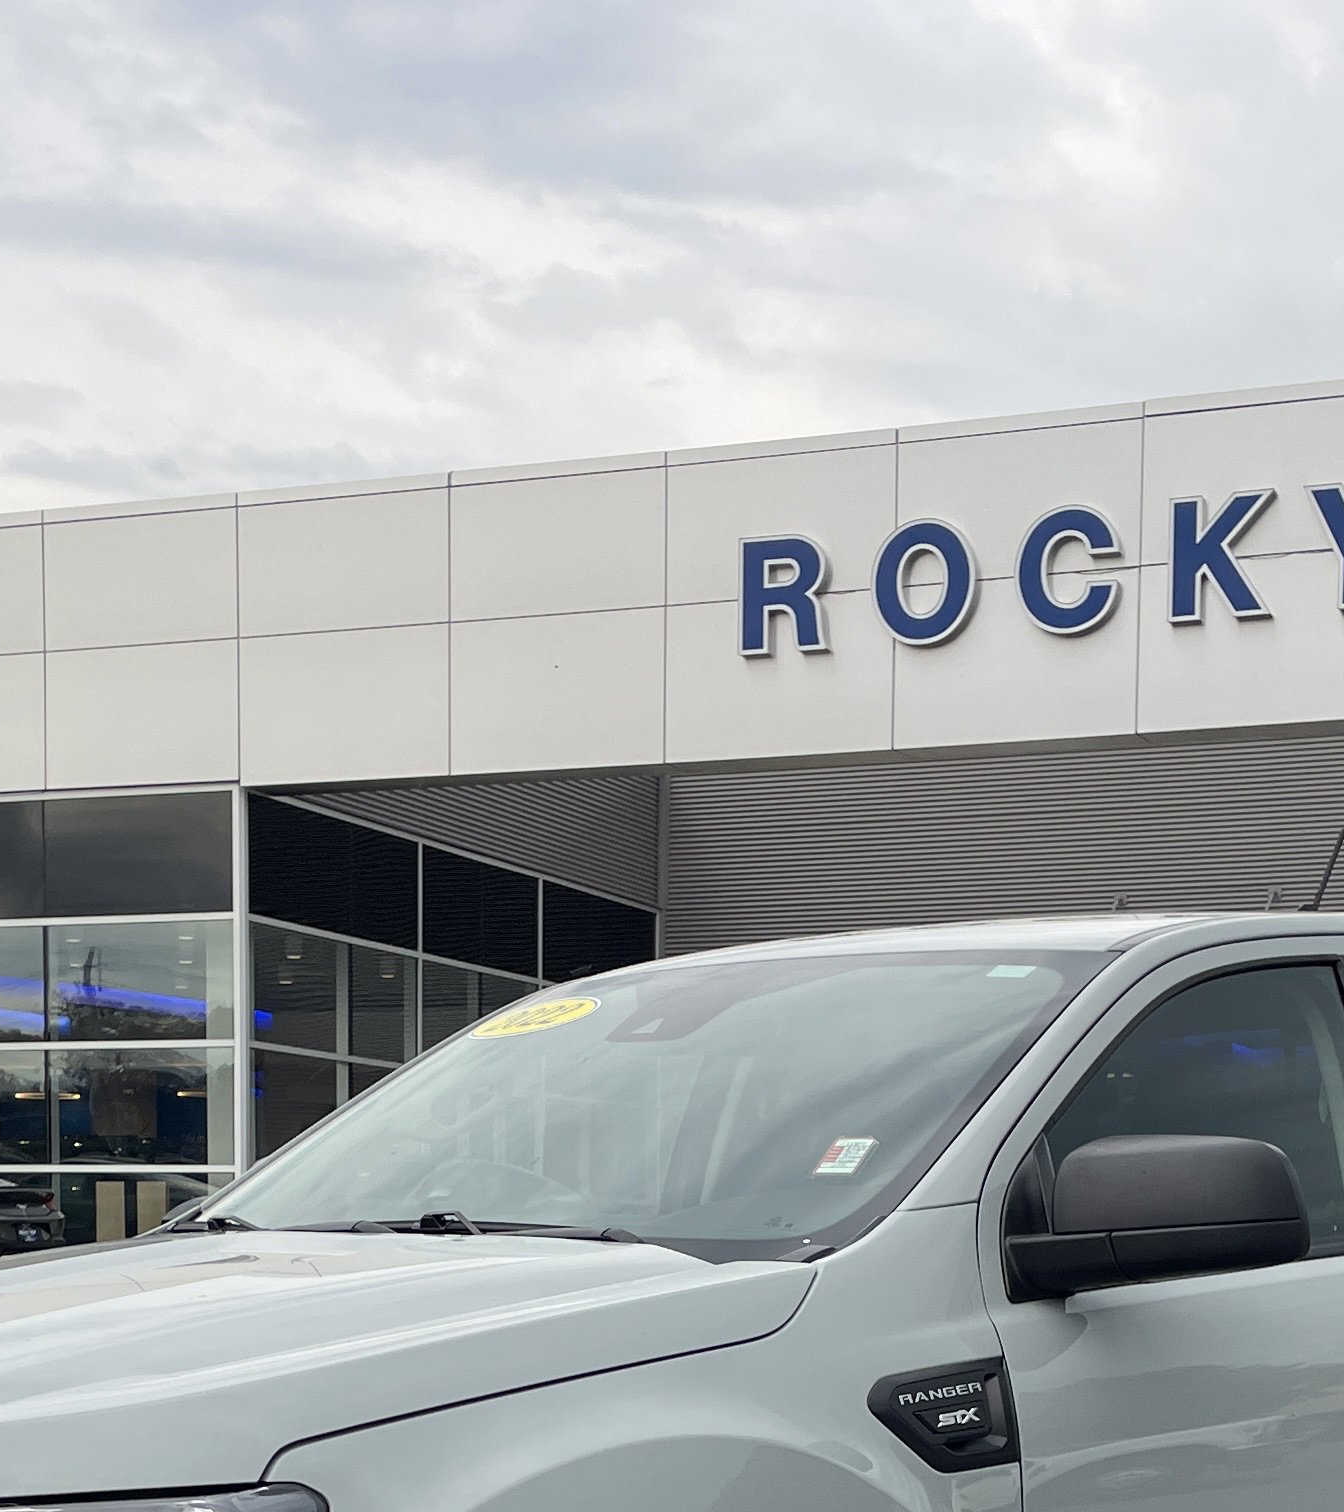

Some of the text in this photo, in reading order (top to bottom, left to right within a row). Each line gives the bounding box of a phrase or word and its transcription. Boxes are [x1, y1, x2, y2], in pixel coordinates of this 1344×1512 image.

[481, 1002, 585, 1033] 2022
[898, 1381, 982, 1406] RANGER
[937, 1407, 980, 1428] STX
